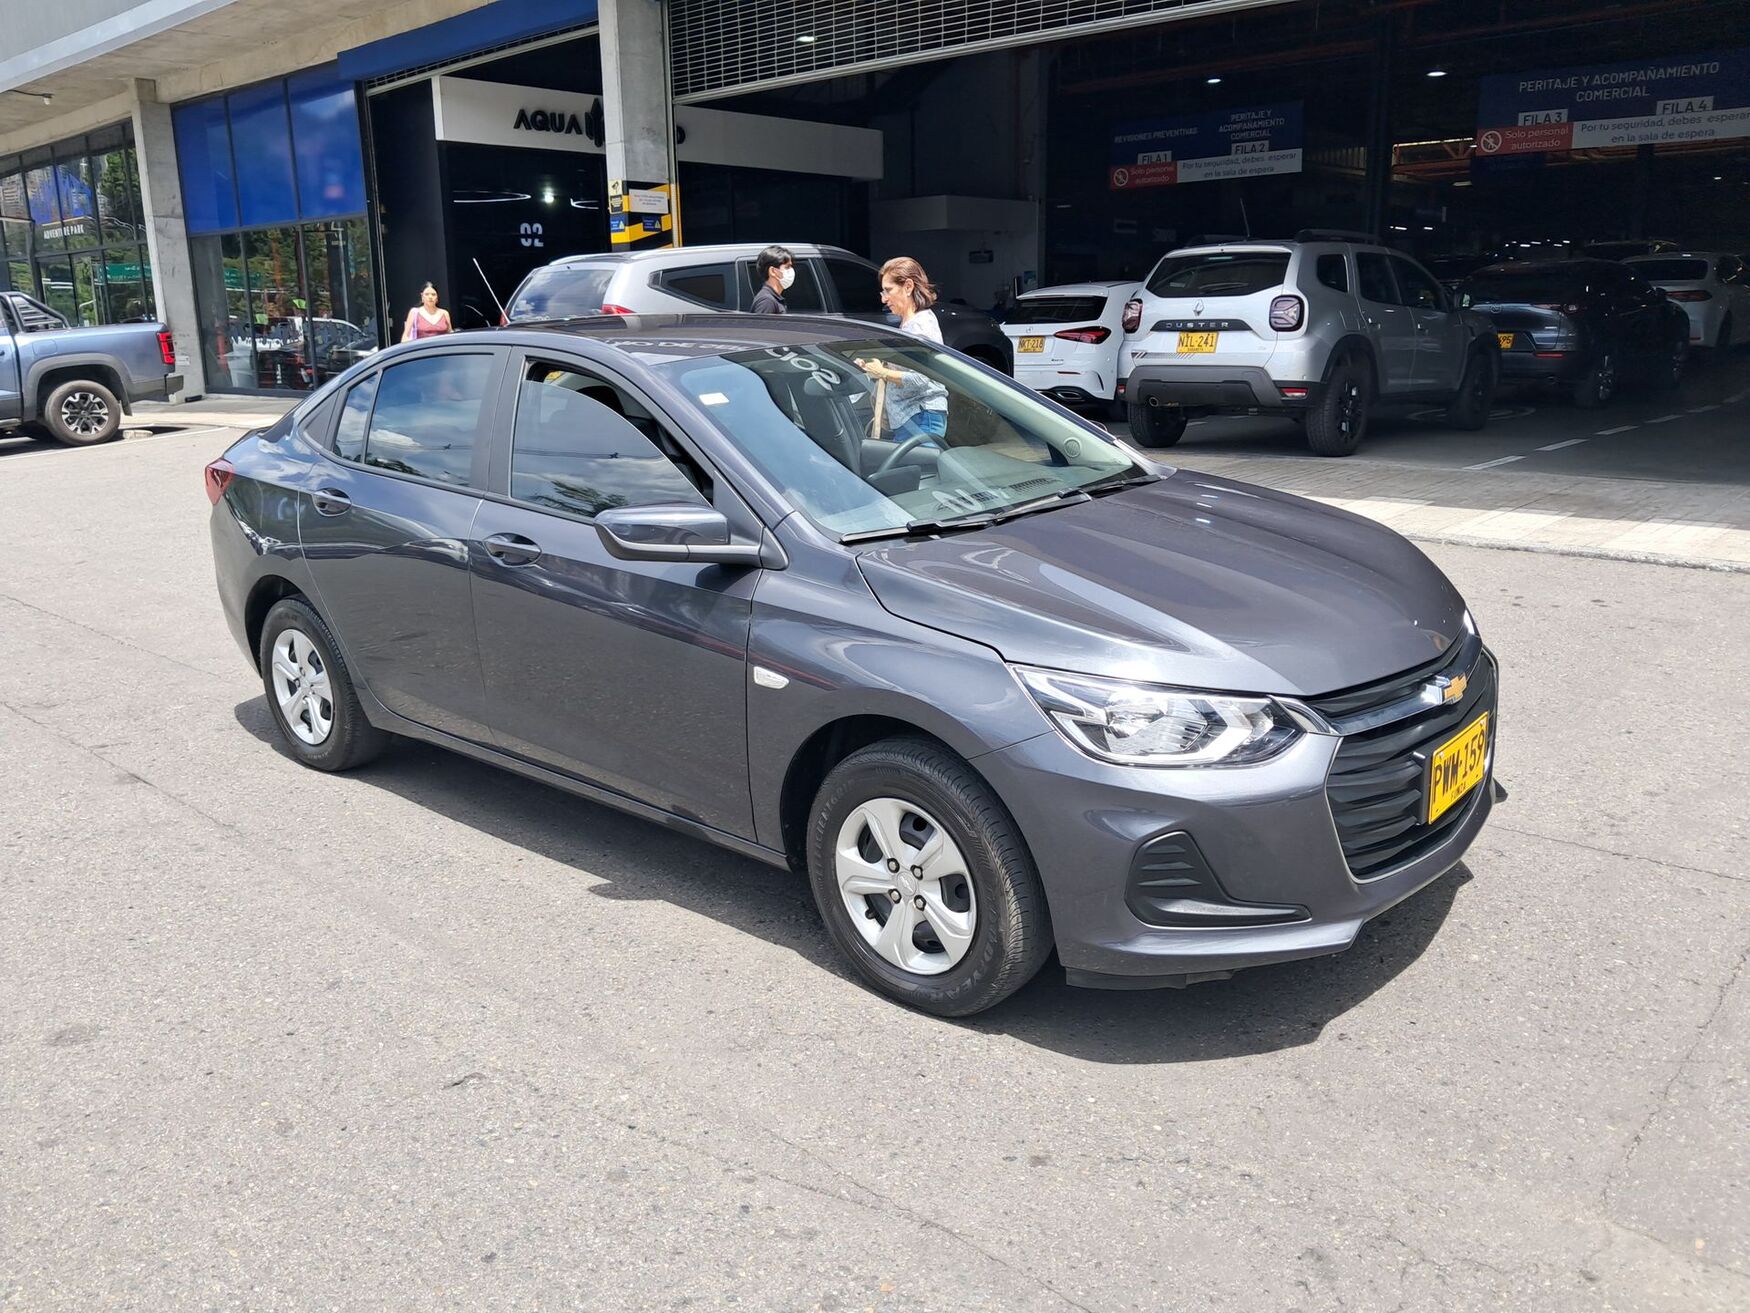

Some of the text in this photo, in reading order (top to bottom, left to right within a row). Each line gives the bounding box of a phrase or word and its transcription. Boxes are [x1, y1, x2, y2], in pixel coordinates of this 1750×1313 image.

[1519, 62, 1720, 92] PERITAJE Y ACOMPAÑAMIENTO
[1576, 86, 1650, 102] COMERCIAL
[1662, 100, 1708, 115] FILA 4
[513, 108, 583, 135] AQUA
[1230, 109, 1272, 122] PERITAJE Y
[1522, 112, 1562, 126] FILA 3
[1580, 110, 1750, 132] Por tu seguridad, debes esperar
[1230, 130, 1272, 140] COMERCIAL
[1504, 126, 1570, 140] Solo personal
[1611, 128, 1715, 144] en la sala de espera
[1234, 143, 1266, 155] FILA 2
[1510, 138, 1561, 150] autorizado
[1142, 154, 1162, 164] FILA
[70, 224, 85, 235] PARK
[520, 222, 544, 248] 02
